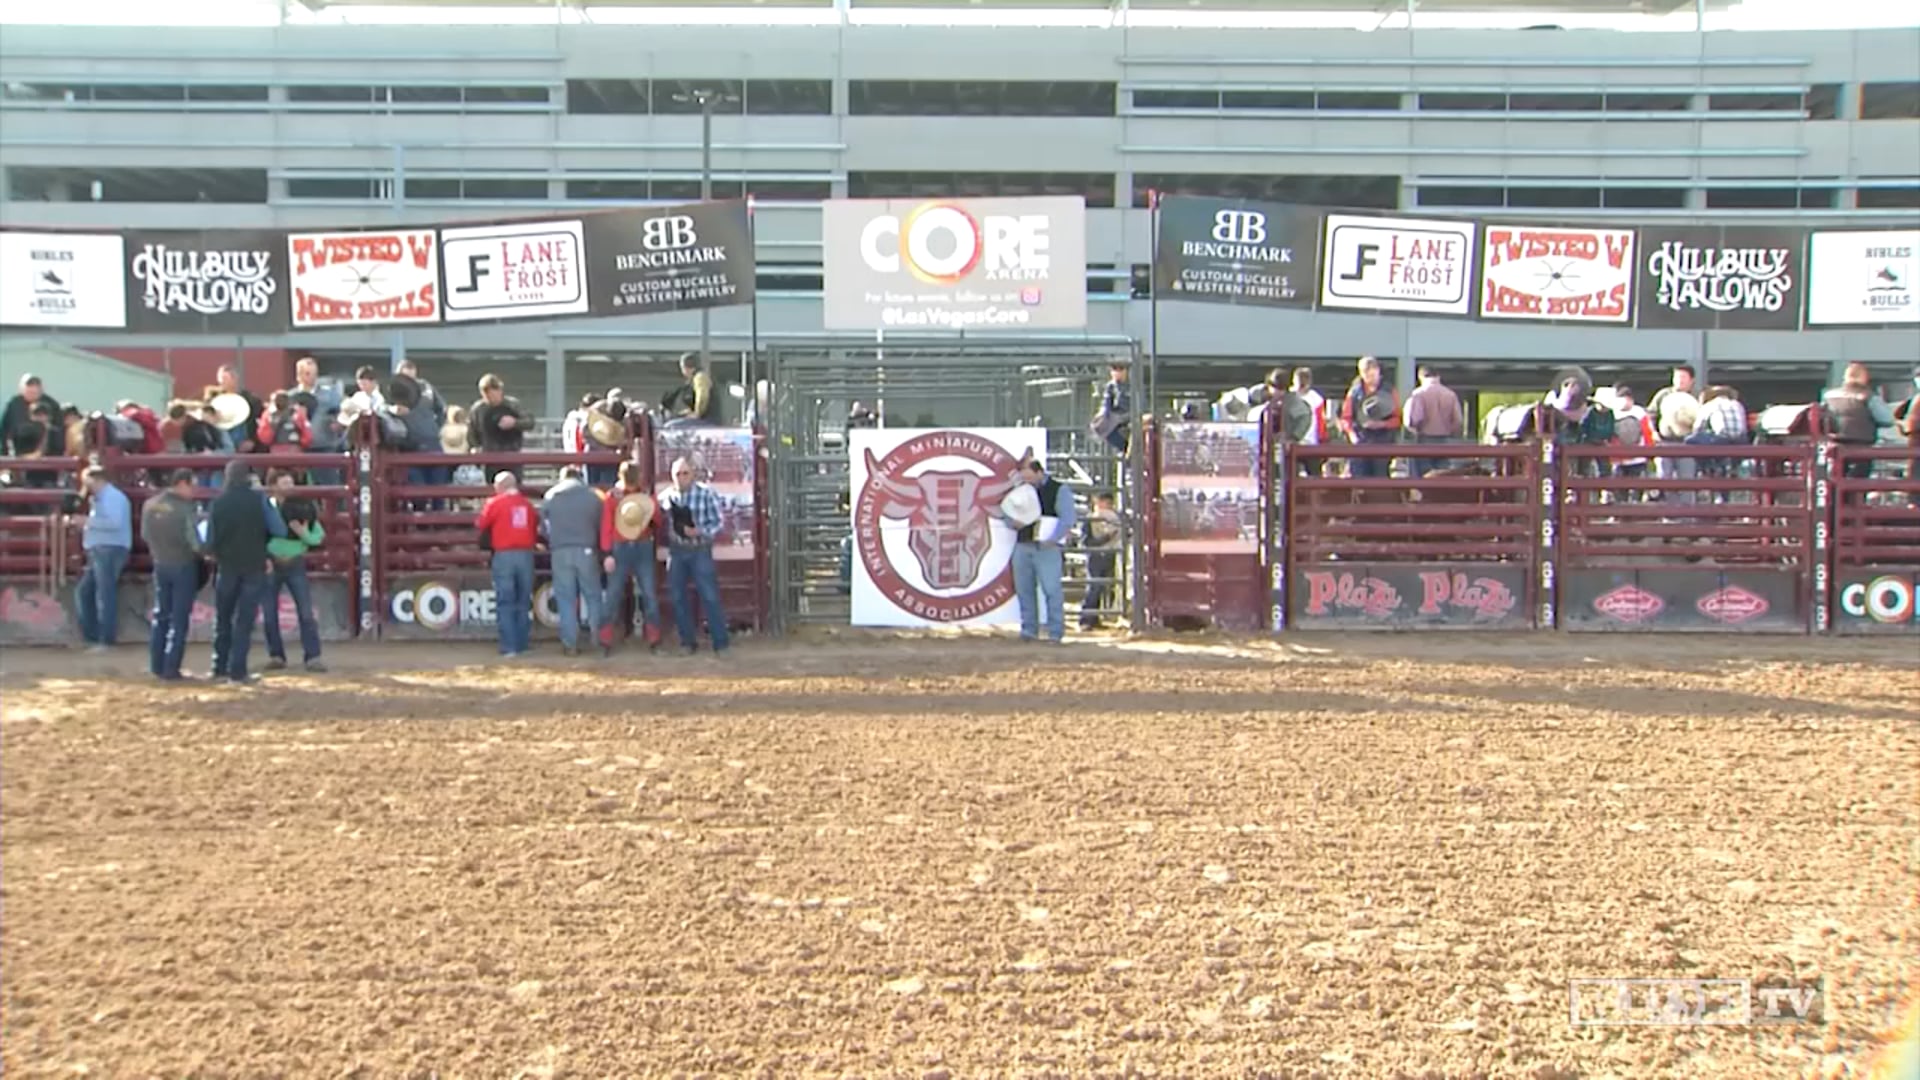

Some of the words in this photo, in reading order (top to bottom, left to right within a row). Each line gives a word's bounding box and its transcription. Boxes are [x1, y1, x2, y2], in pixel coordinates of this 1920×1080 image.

[502, 240, 567, 267] LANE
[860, 204, 1049, 277] CORE
[1182, 241, 1292, 263] BENCHMARK
[1391, 235, 1456, 261] LANE
[1490, 231, 1599, 266] TWISTED
[1605, 235, 1629, 269] W
[293, 236, 403, 275] TWISTED
[408, 235, 432, 269] W
[616, 246, 727, 270] BENCHMARK
[504, 267, 569, 292] FROST
[620, 278, 671, 294] CUSTOM
[674, 274, 727, 289] BUCKLES
[985, 269, 1049, 280] ARENA
[1182, 269, 1233, 282] CUSTOM
[1236, 273, 1288, 286] BUCKLES
[1389, 263, 1454, 286] FROST
[358, 282, 434, 318] BULLS
[624, 290, 682, 304] WESTERN
[684, 285, 736, 299] JEWELRY
[1185, 281, 1242, 295] WESTERN
[1245, 285, 1296, 298] JEWELRY
[1547, 282, 1625, 316] BULLS
[882, 306, 1029, 327] @LasVegasCore
[862, 455, 904, 577] INTERNATIONAL
[910, 436, 1005, 465] MINIATURE
[392, 584, 497, 625] CORE
[894, 585, 1008, 620] ASSOCIATION
[1304, 571, 1402, 618] Plaza
[1418, 571, 1515, 617] Plaza
[1842, 578, 1920, 617] CO
